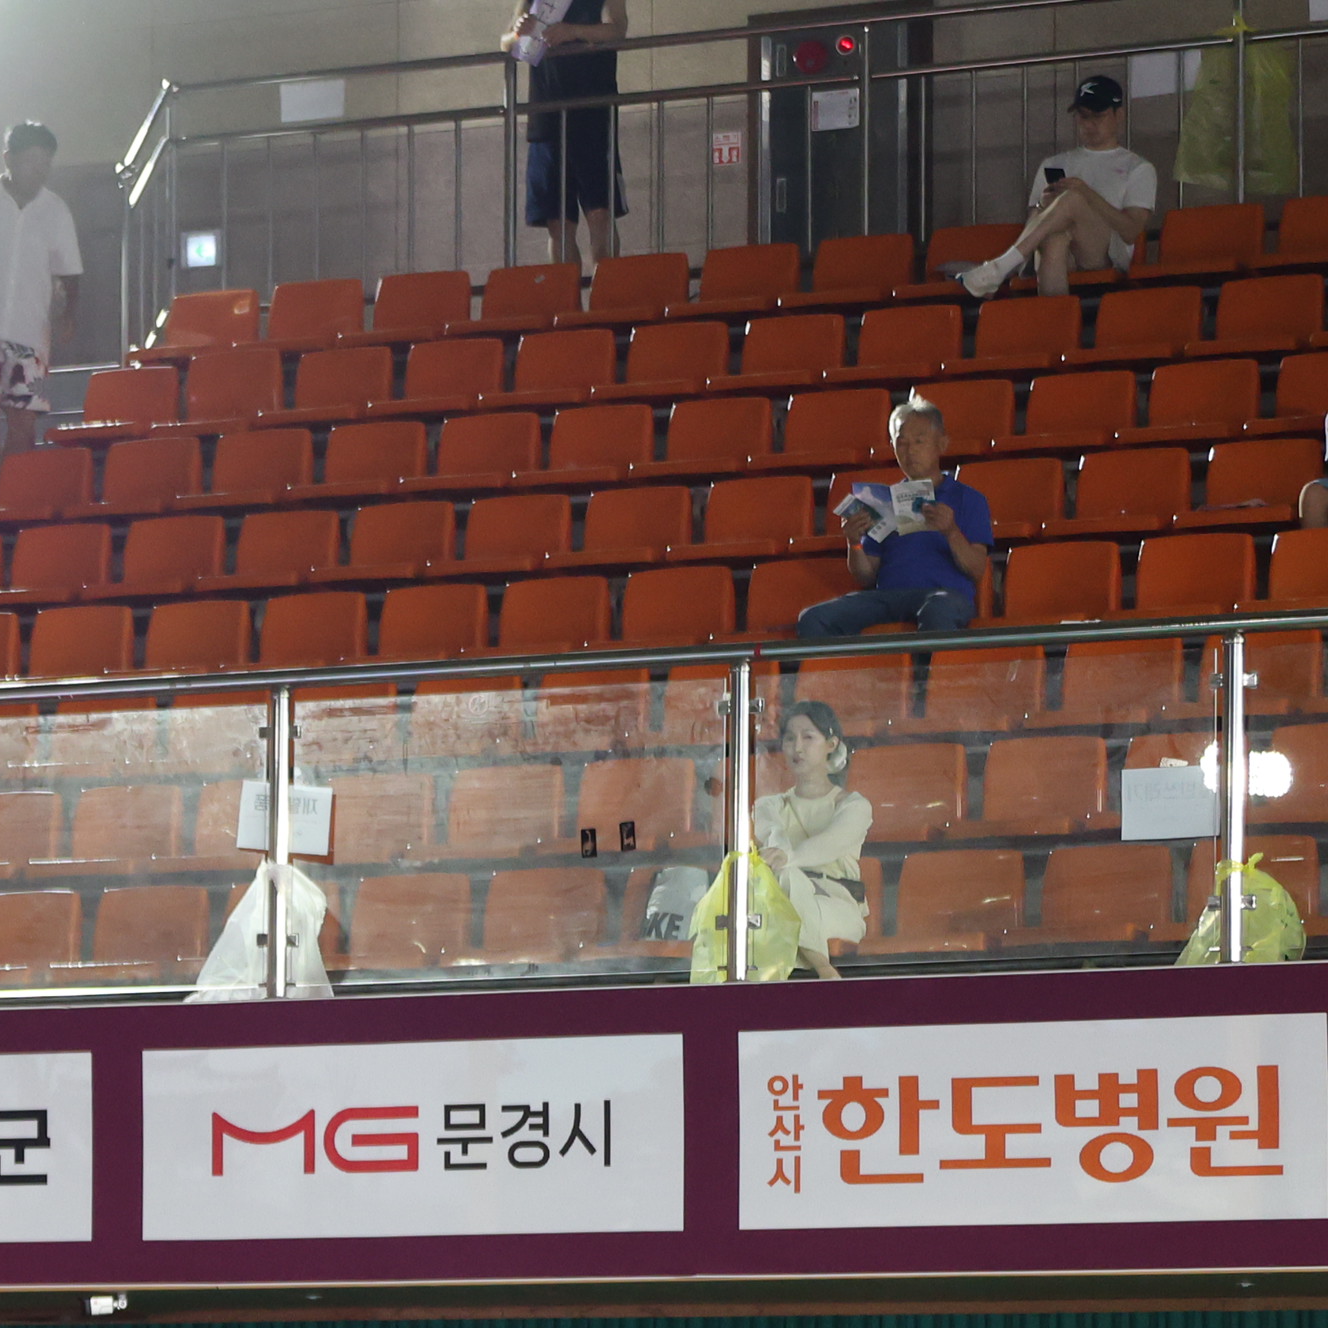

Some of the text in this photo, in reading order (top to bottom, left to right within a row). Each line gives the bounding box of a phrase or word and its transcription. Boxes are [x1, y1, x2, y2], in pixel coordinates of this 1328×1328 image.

[211, 1099, 611, 1177] MG 문경시
[767, 1074, 805, 1194] 안산시
[817, 1064, 1284, 1185] 한도병원
